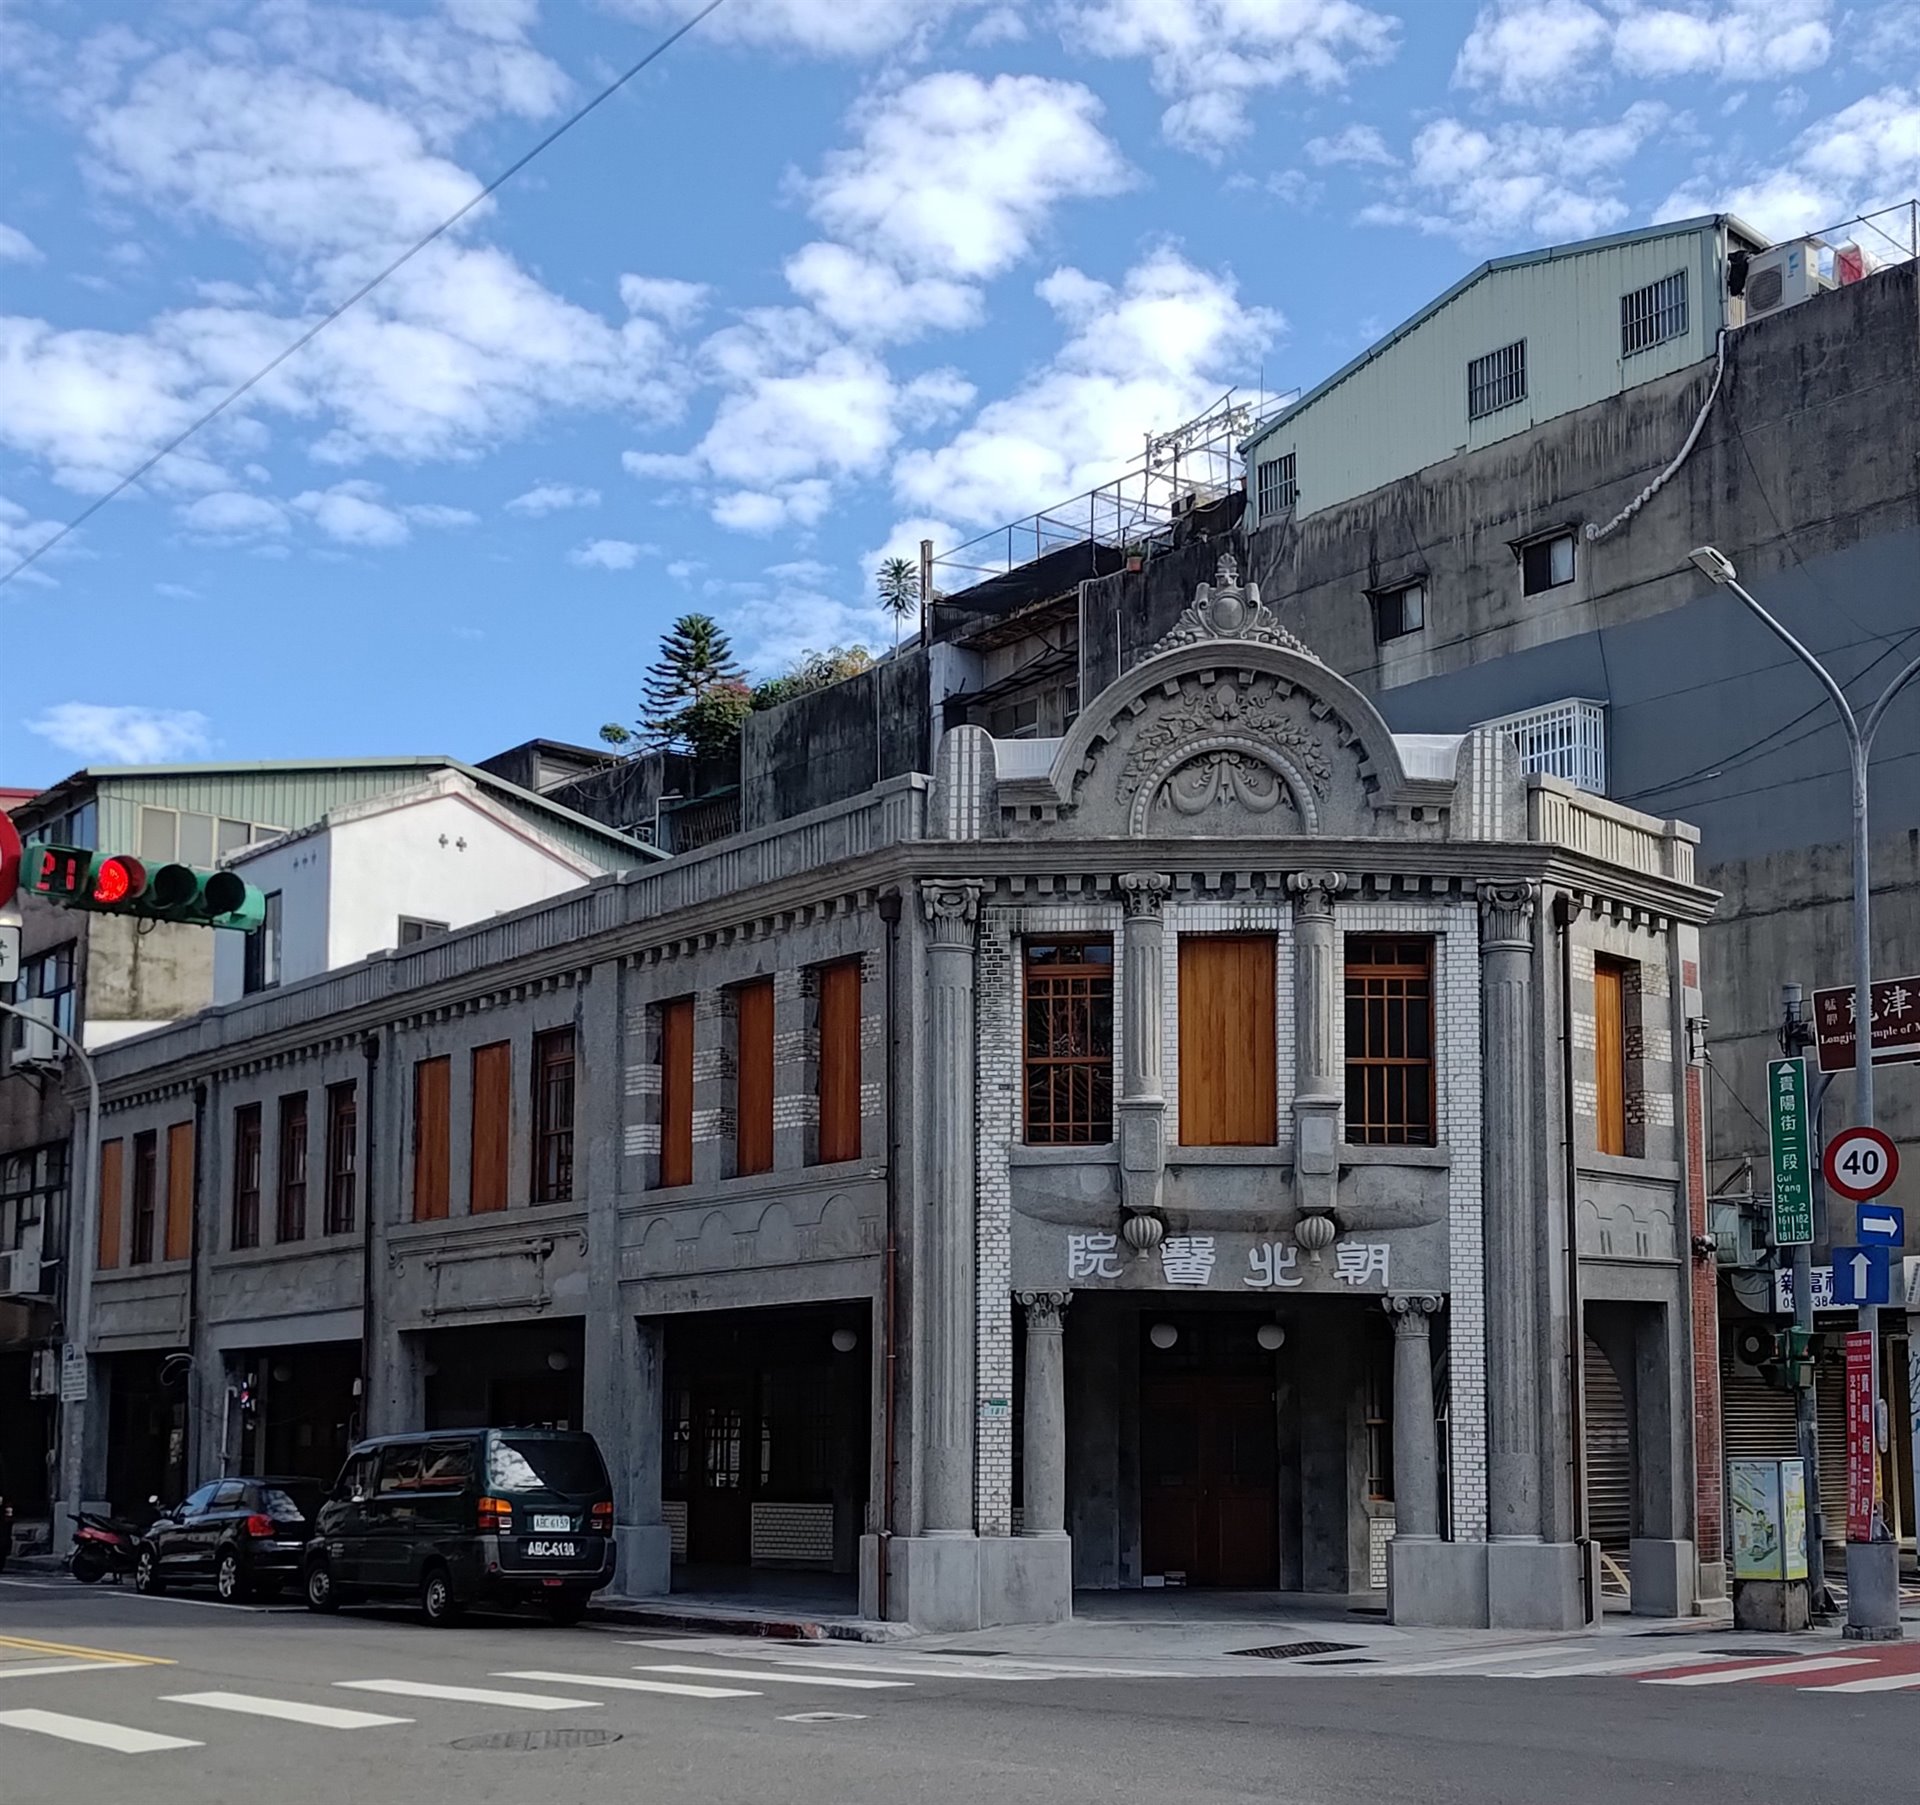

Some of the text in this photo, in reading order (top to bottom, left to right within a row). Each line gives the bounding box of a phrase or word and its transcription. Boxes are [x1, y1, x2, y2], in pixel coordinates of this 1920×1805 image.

[1845, 985, 1920, 1024] 龍津
[1868, 1026, 1898, 1039] mple
[1900, 1023, 1912, 1034] of
[1779, 1076, 1798, 1170] 貴陽街二段
[1843, 1150, 1879, 1175] 40
[1777, 1174, 1792, 1183] Gui
[1777, 1184, 1801, 1194] Yang
[1798, 1202, 1806, 1212] 2
